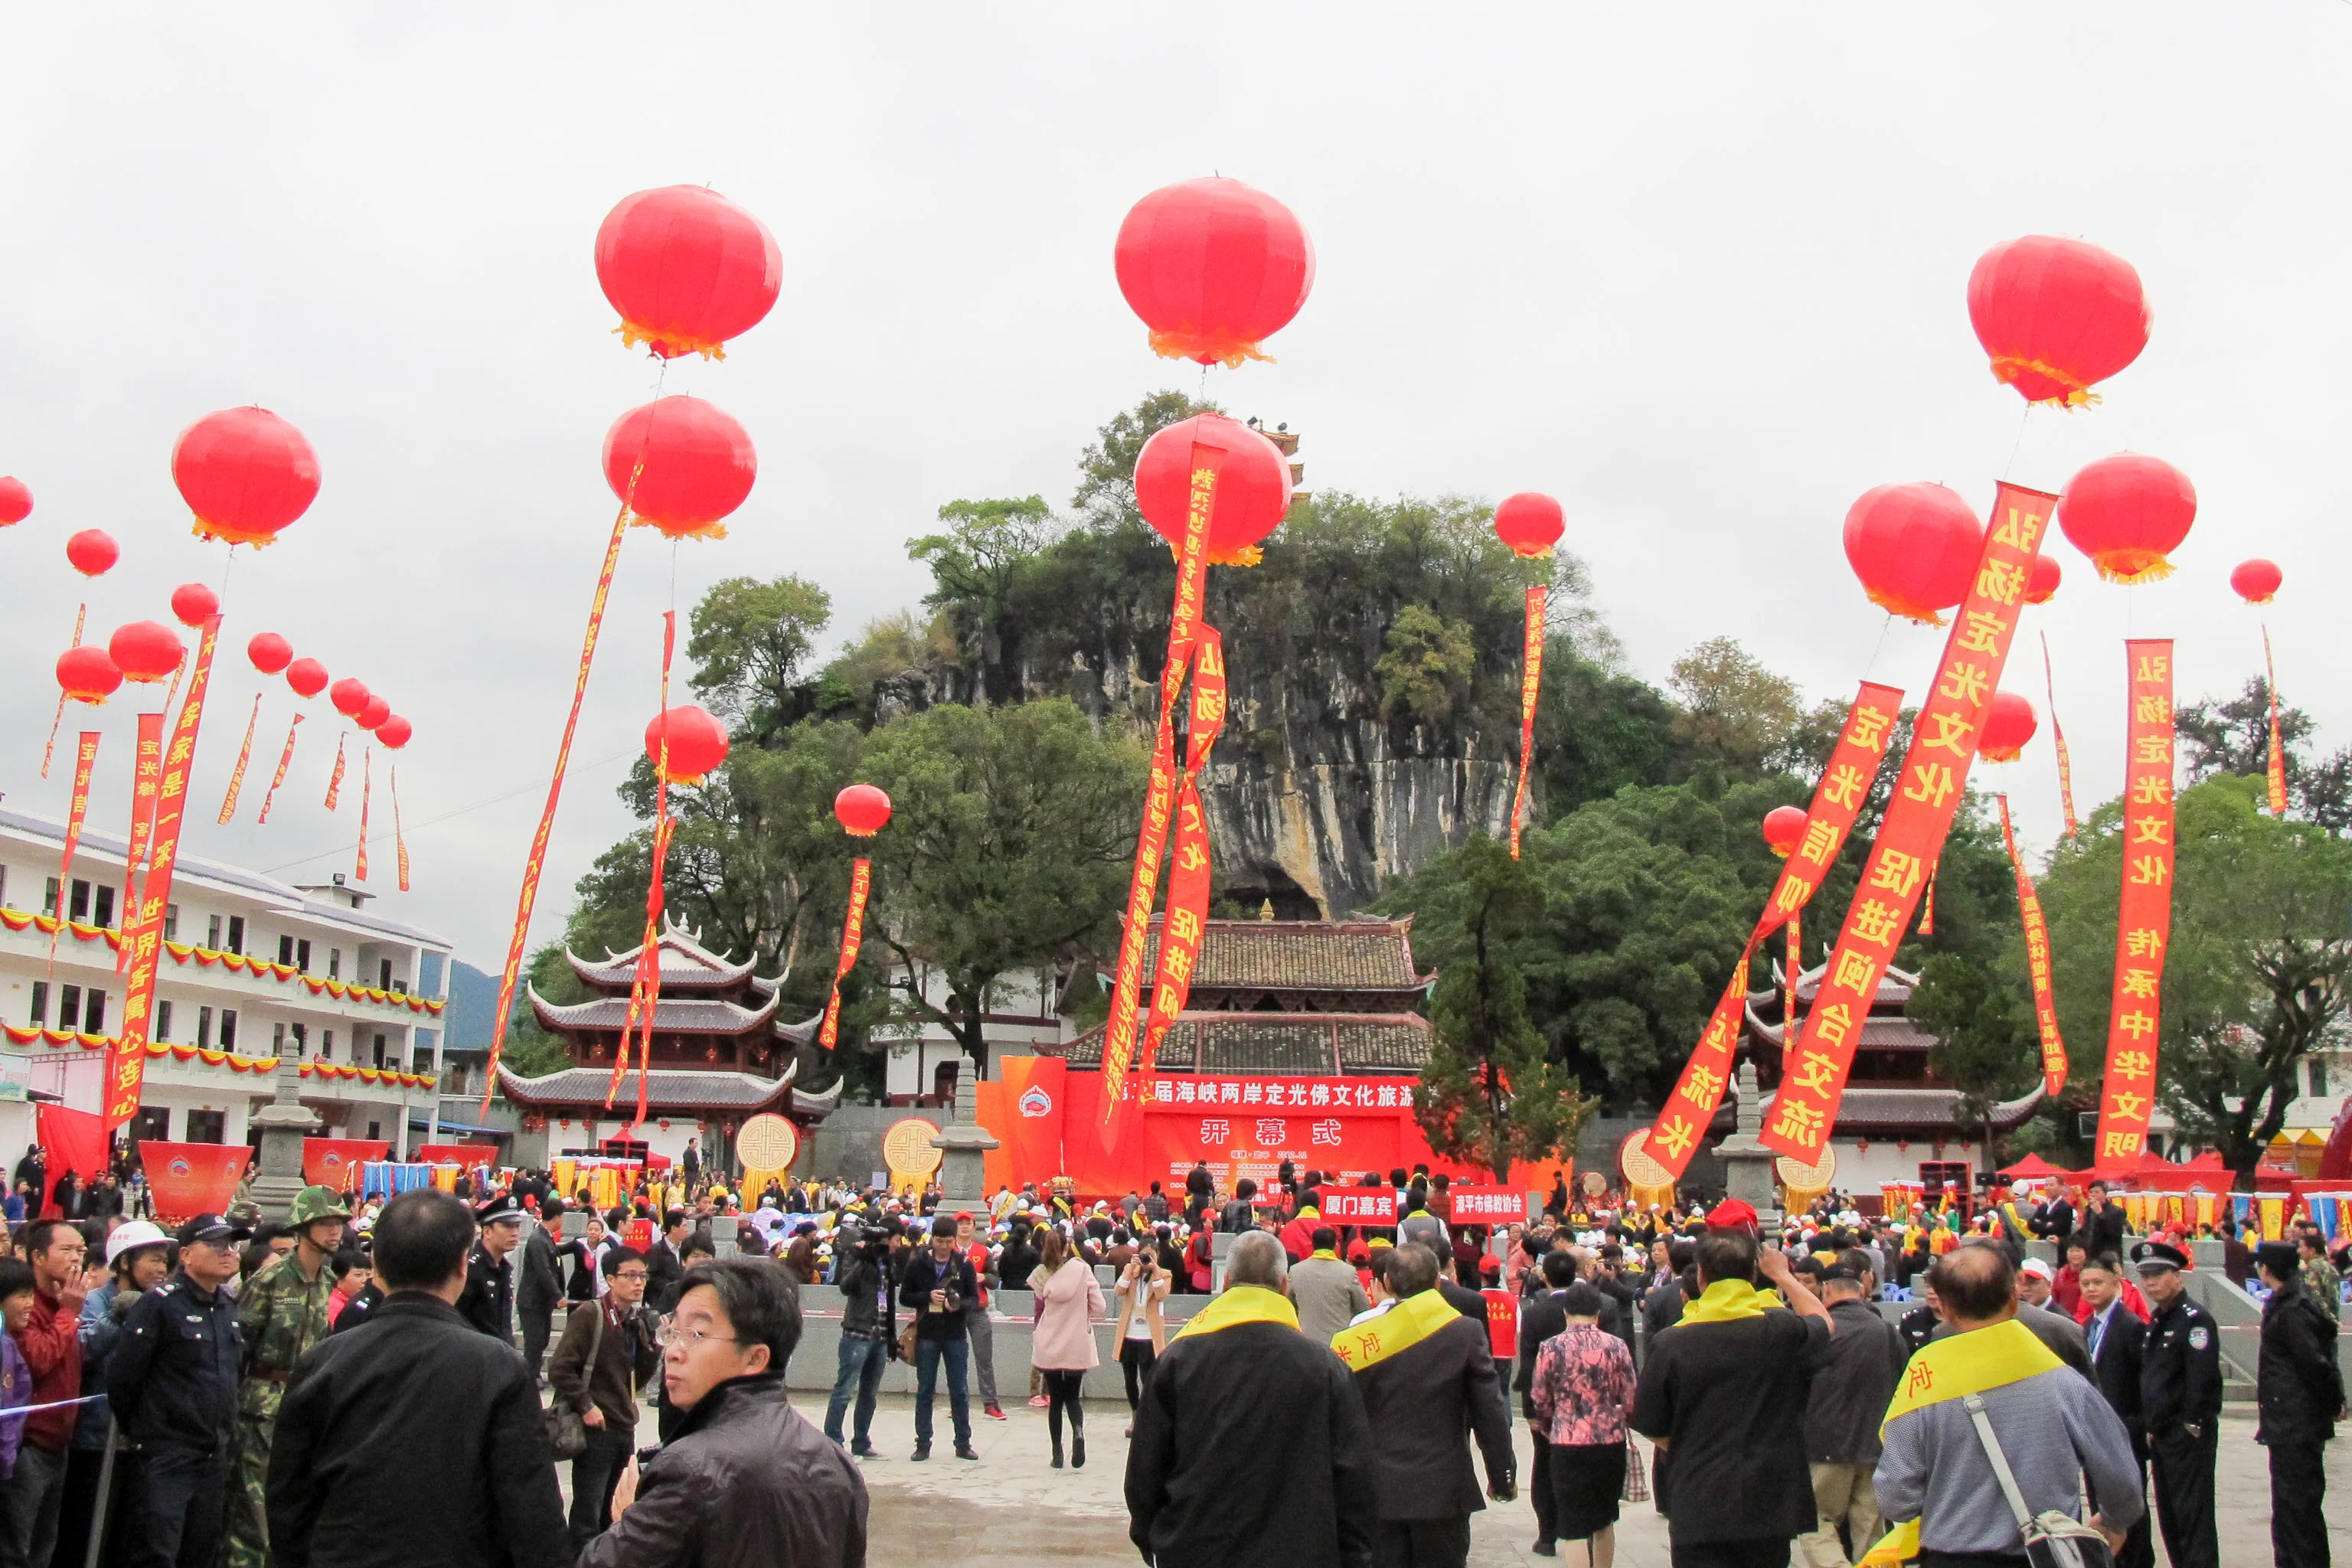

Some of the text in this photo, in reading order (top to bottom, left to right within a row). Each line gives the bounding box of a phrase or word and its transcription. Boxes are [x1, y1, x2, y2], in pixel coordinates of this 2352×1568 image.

[154, 633, 217, 870] 天下客家是一家
[112, 896, 164, 1117] 世界客属心连心
[1200, 1118, 1342, 1147] 开幕式
[1325, 1195, 1393, 1217] 厦门嘉宾
[1455, 1194, 1522, 1214] 漳平市佛教协会
